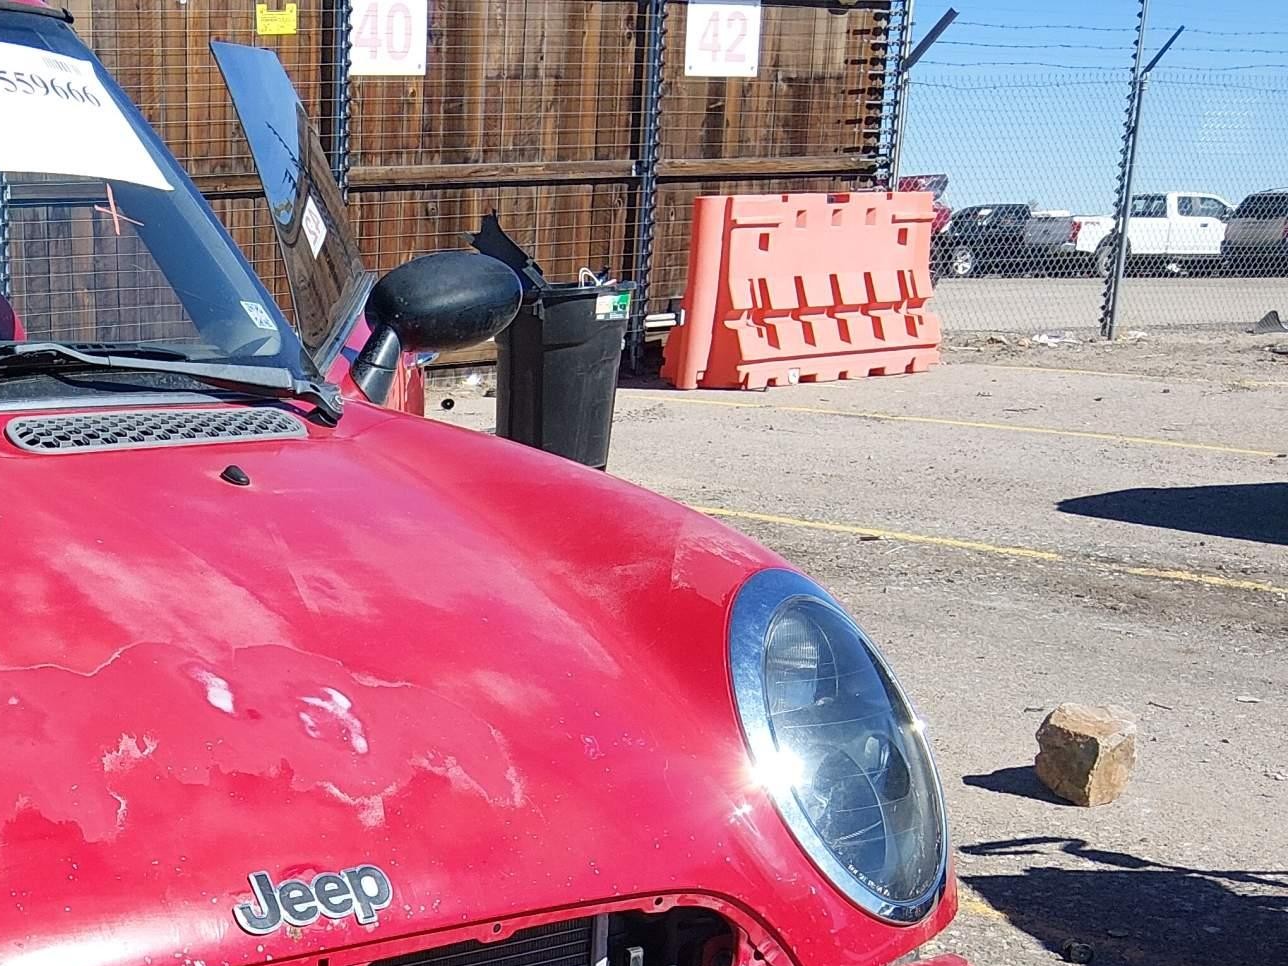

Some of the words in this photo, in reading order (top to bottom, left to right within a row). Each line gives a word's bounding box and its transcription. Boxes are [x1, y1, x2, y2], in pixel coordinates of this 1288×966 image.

[355, 2, 413, 61] 40
[698, 11, 748, 63] 42
[232, 864, 393, 934] Jeep
